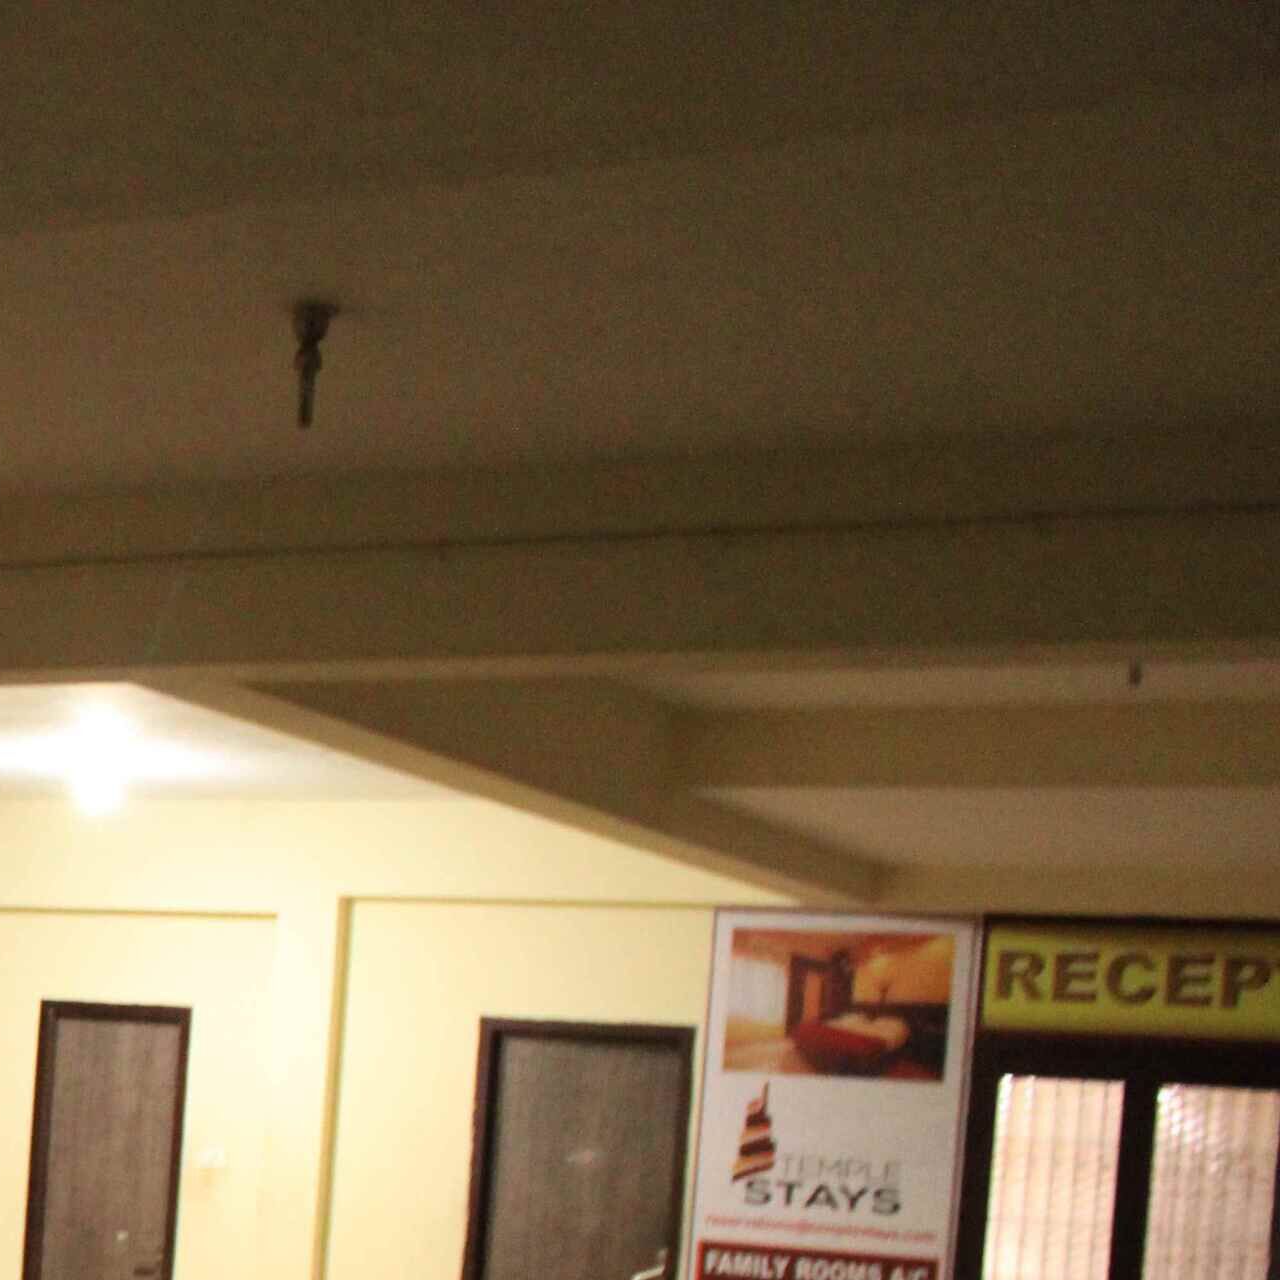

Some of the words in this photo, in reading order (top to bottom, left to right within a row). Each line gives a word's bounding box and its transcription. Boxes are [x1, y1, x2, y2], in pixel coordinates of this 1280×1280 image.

[994, 951, 1280, 1008] RECEP
[780, 1154, 902, 1183] TEMPLE
[744, 1179, 903, 1215] STAYS
[704, 1249, 791, 1279] FAMILY
